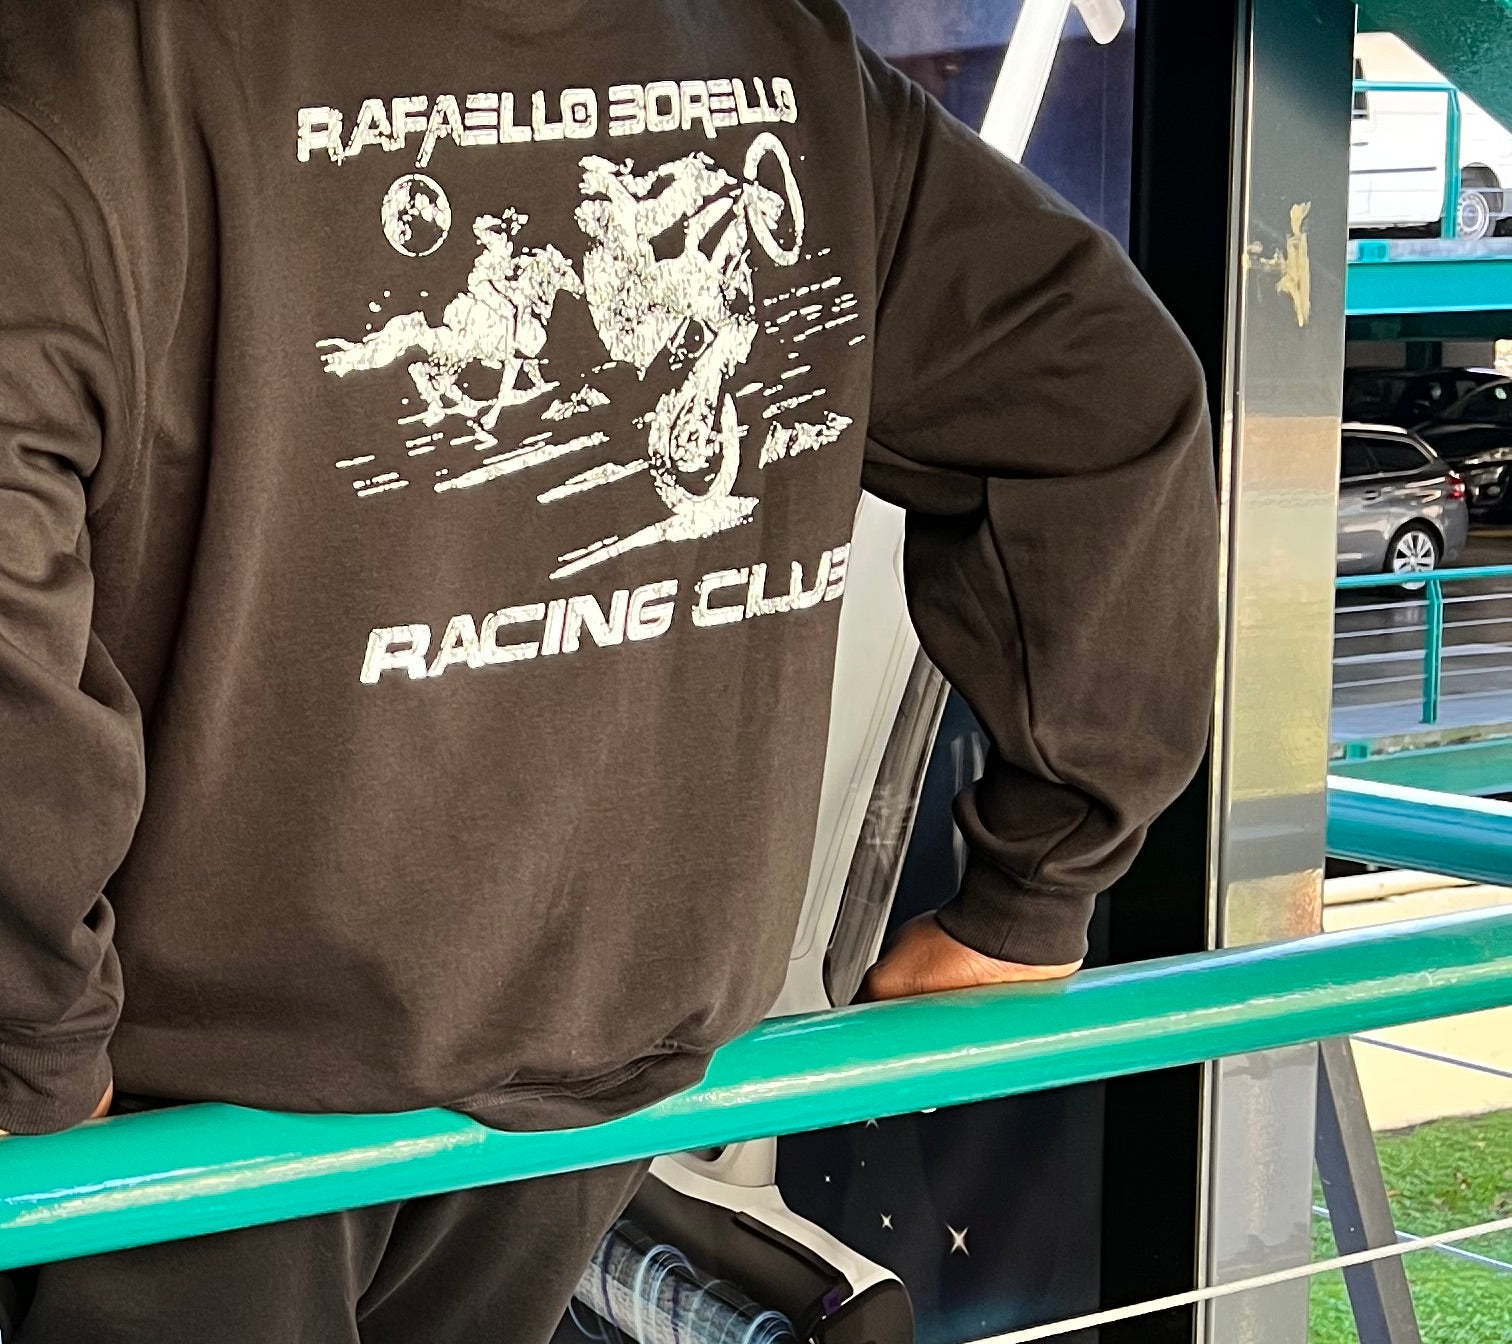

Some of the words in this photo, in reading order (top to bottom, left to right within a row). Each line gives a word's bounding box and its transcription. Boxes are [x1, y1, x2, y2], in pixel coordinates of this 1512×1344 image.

[297, 88, 597, 168] RAFAELLO
[608, 76, 798, 139] BORELLO
[359, 579, 679, 685] RACING
[691, 542, 852, 628] CLUB
